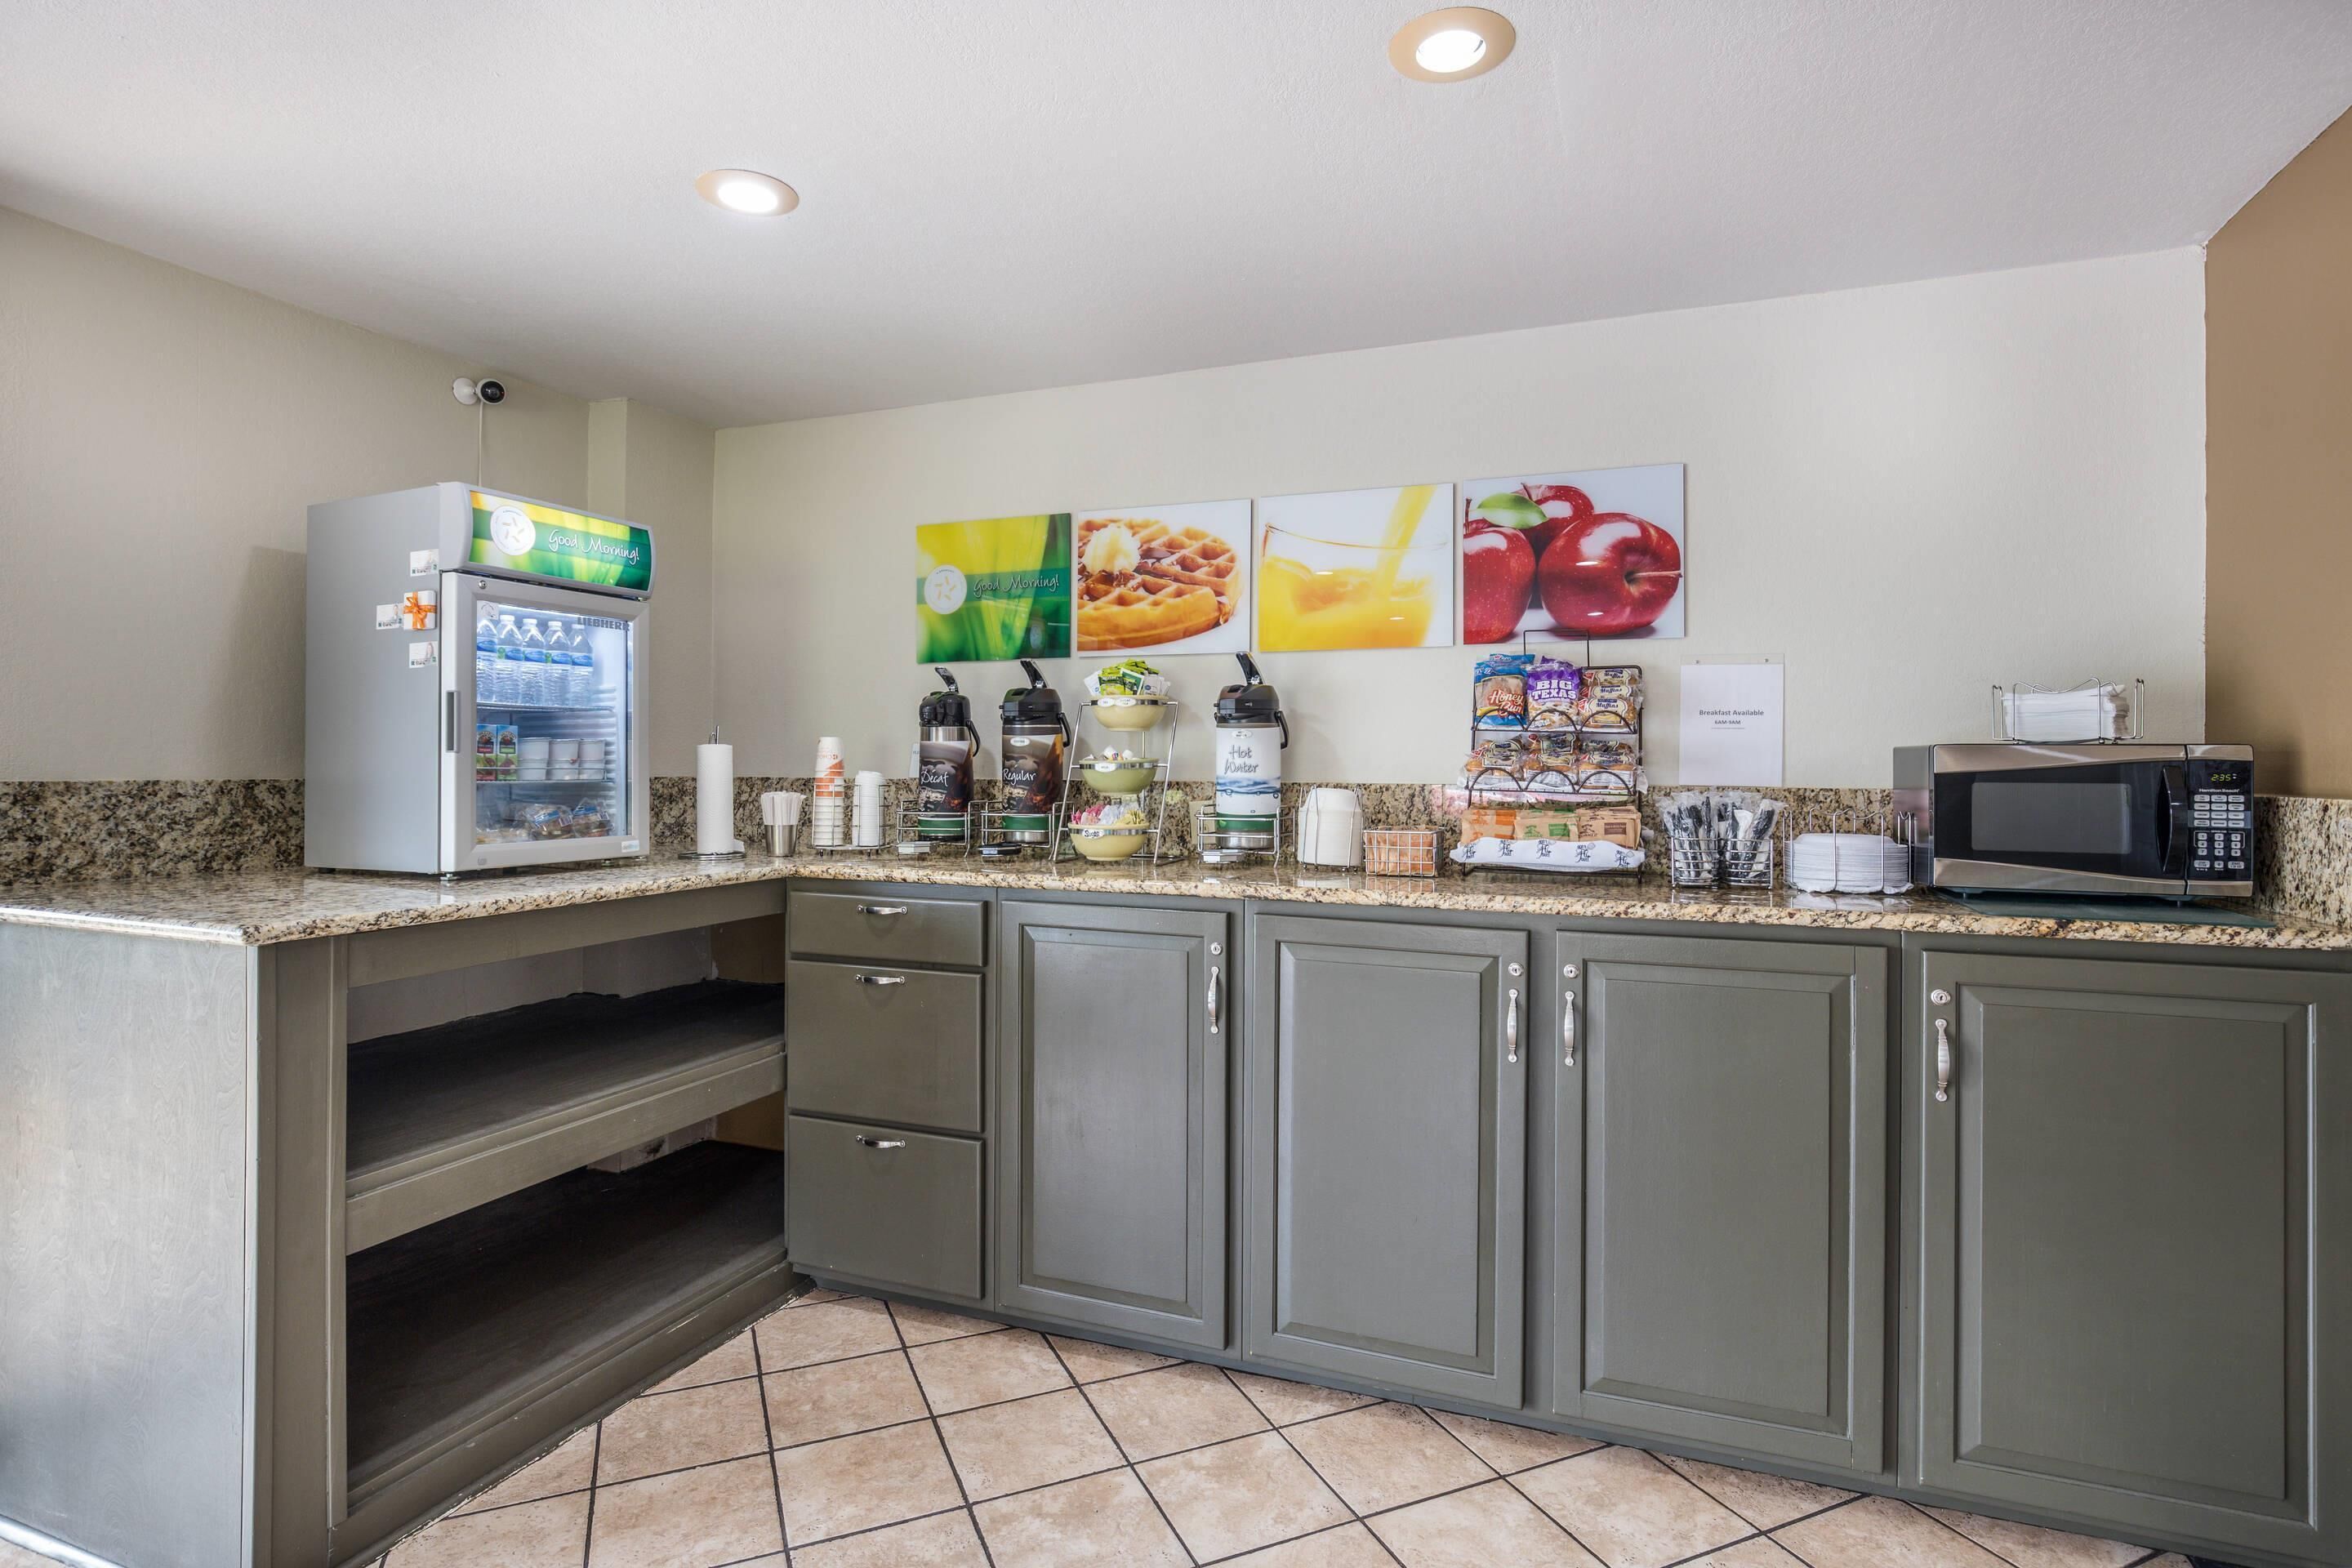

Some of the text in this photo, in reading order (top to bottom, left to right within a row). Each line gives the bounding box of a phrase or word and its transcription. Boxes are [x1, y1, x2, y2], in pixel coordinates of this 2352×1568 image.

[549, 529, 639, 565] Good Morning!
[973, 573, 1059, 598] Good Morning!
[577, 617, 630, 631] LIEBHERR
[1536, 679, 1572, 690] BIG
[1489, 689, 1524, 705] Honey
[1532, 688, 1577, 700] TEXAS
[1499, 702, 1521, 716] Bun
[1228, 744, 1253, 760] Hot
[1224, 759, 1259, 775] Water
[920, 768, 949, 786] Decaf
[1003, 768, 1036, 785] Regular
[2211, 773, 2231, 782] 2:35
